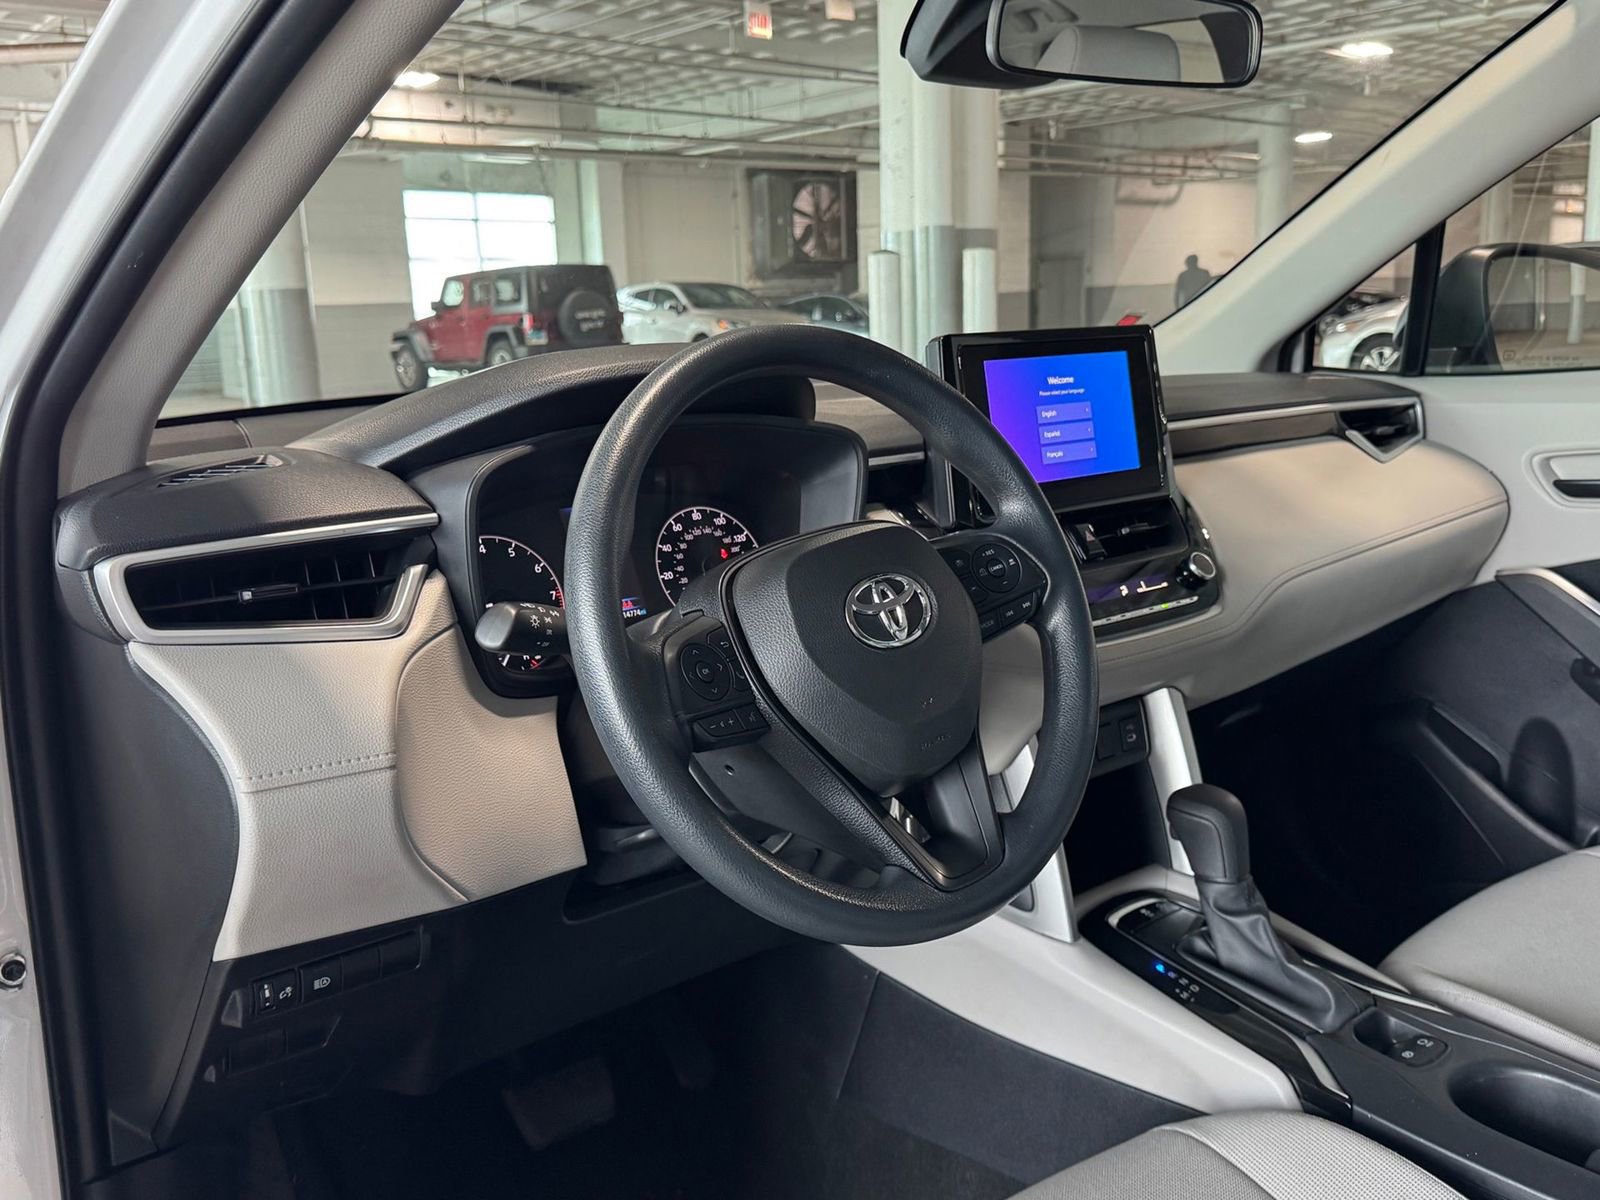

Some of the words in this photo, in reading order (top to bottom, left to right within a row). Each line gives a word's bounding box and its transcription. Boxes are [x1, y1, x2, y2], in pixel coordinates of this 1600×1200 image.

[1047, 376, 1074, 384] Welcome
[1042, 410, 1057, 418] English
[692, 512, 702, 520] 80
[714, 516, 726, 525] 100
[672, 524, 682, 532] 60
[480, 544, 486, 554] 4
[508, 548, 516, 558] 5
[534, 564, 542, 574] 6
[663, 572, 674, 580] 20
[550, 590, 556, 600] 7
